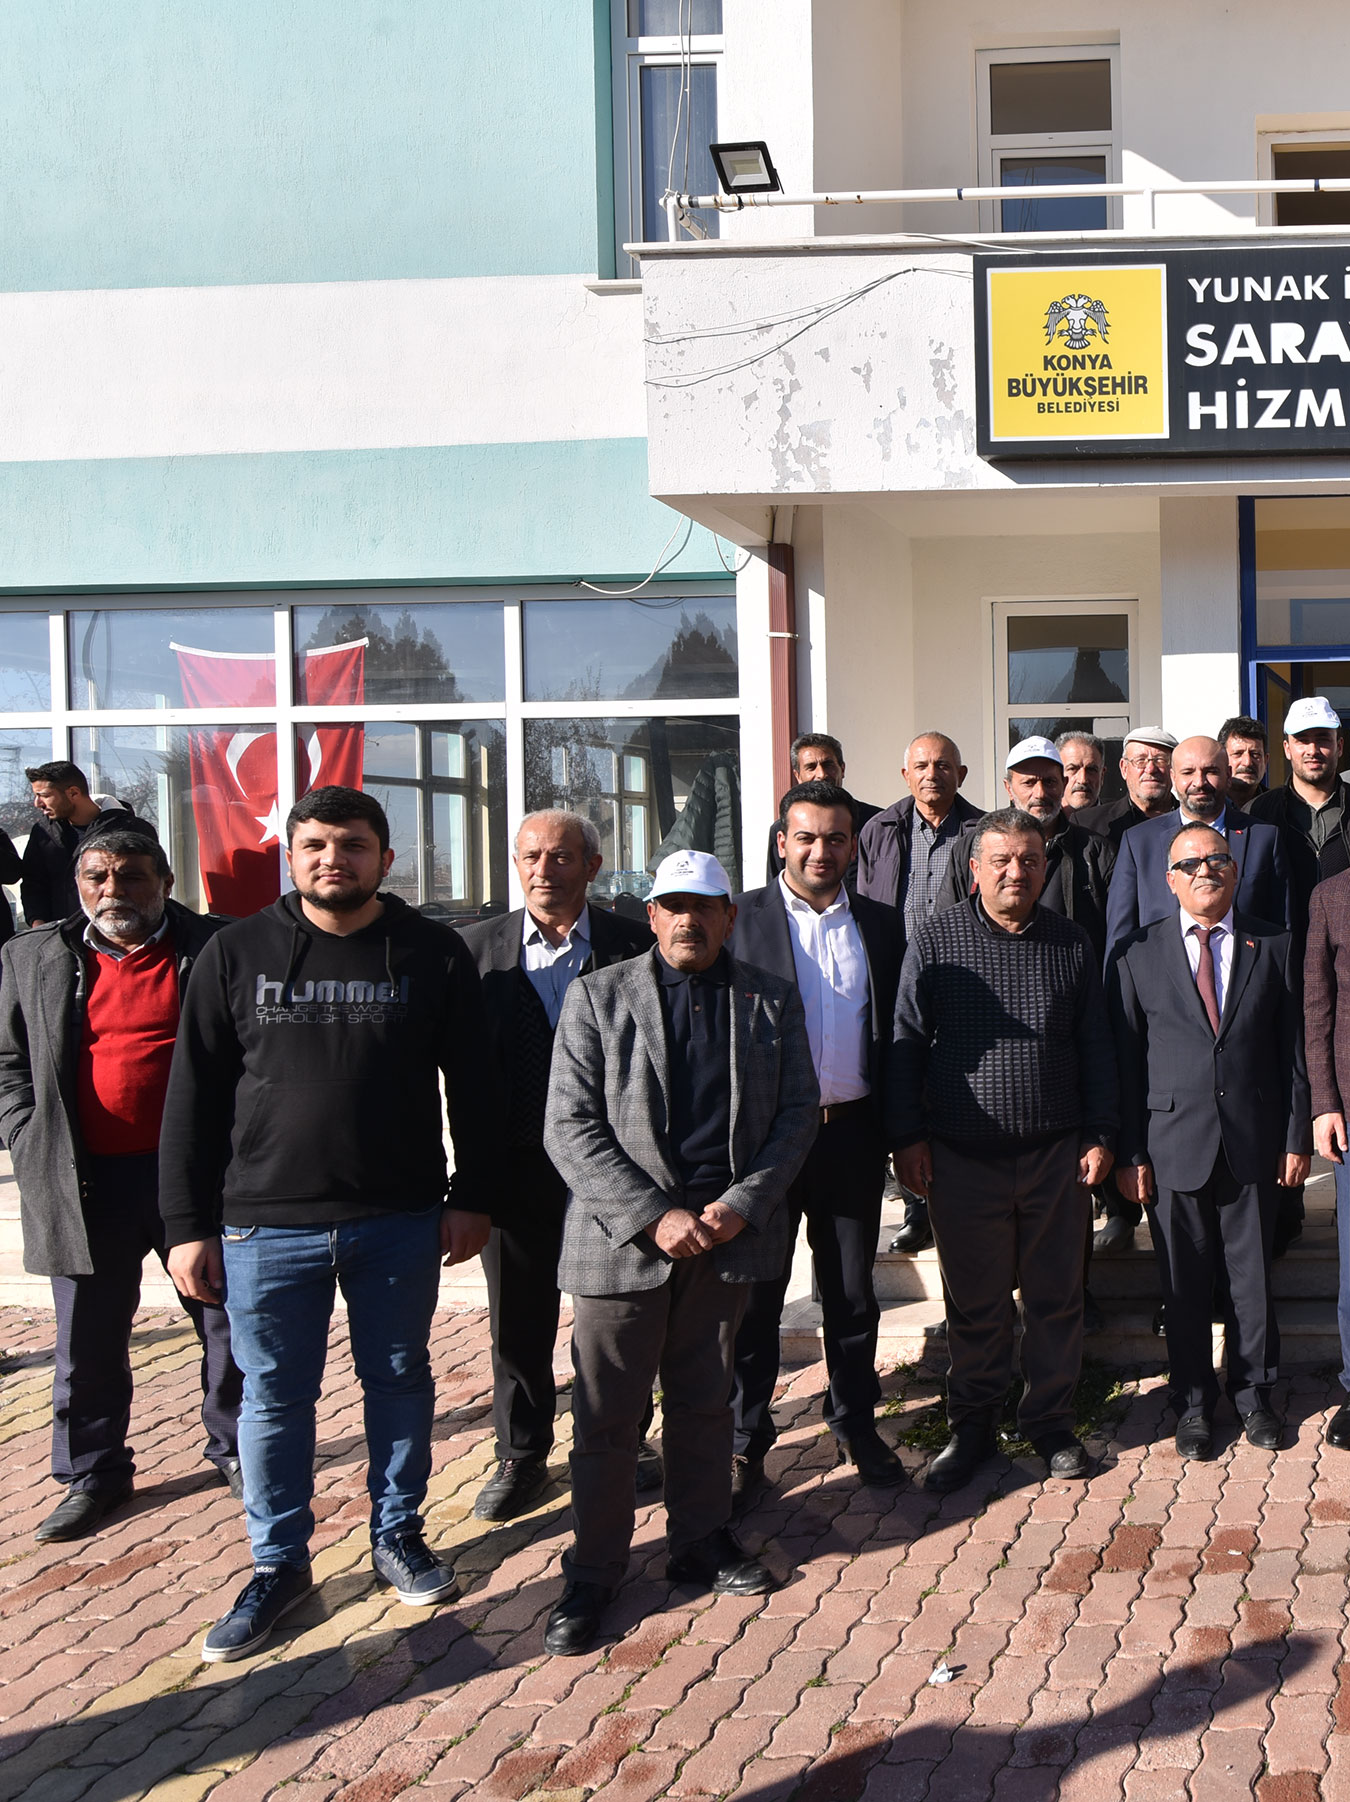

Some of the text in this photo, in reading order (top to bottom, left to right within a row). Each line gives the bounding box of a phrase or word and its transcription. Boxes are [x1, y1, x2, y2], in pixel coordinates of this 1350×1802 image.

[1187, 274, 1330, 303] YUNAK
[1043, 353, 1113, 371] KONYA
[1007, 371, 1148, 400] BÜYÜKŞEHİR
[1037, 398, 1120, 414] BELEDİYESİ
[256, 973, 409, 1005] hummel
[322, 1004, 350, 1013] THE
[352, 1004, 408, 1013] WORLD
[256, 1013, 408, 1025] THROUGH SPORT
